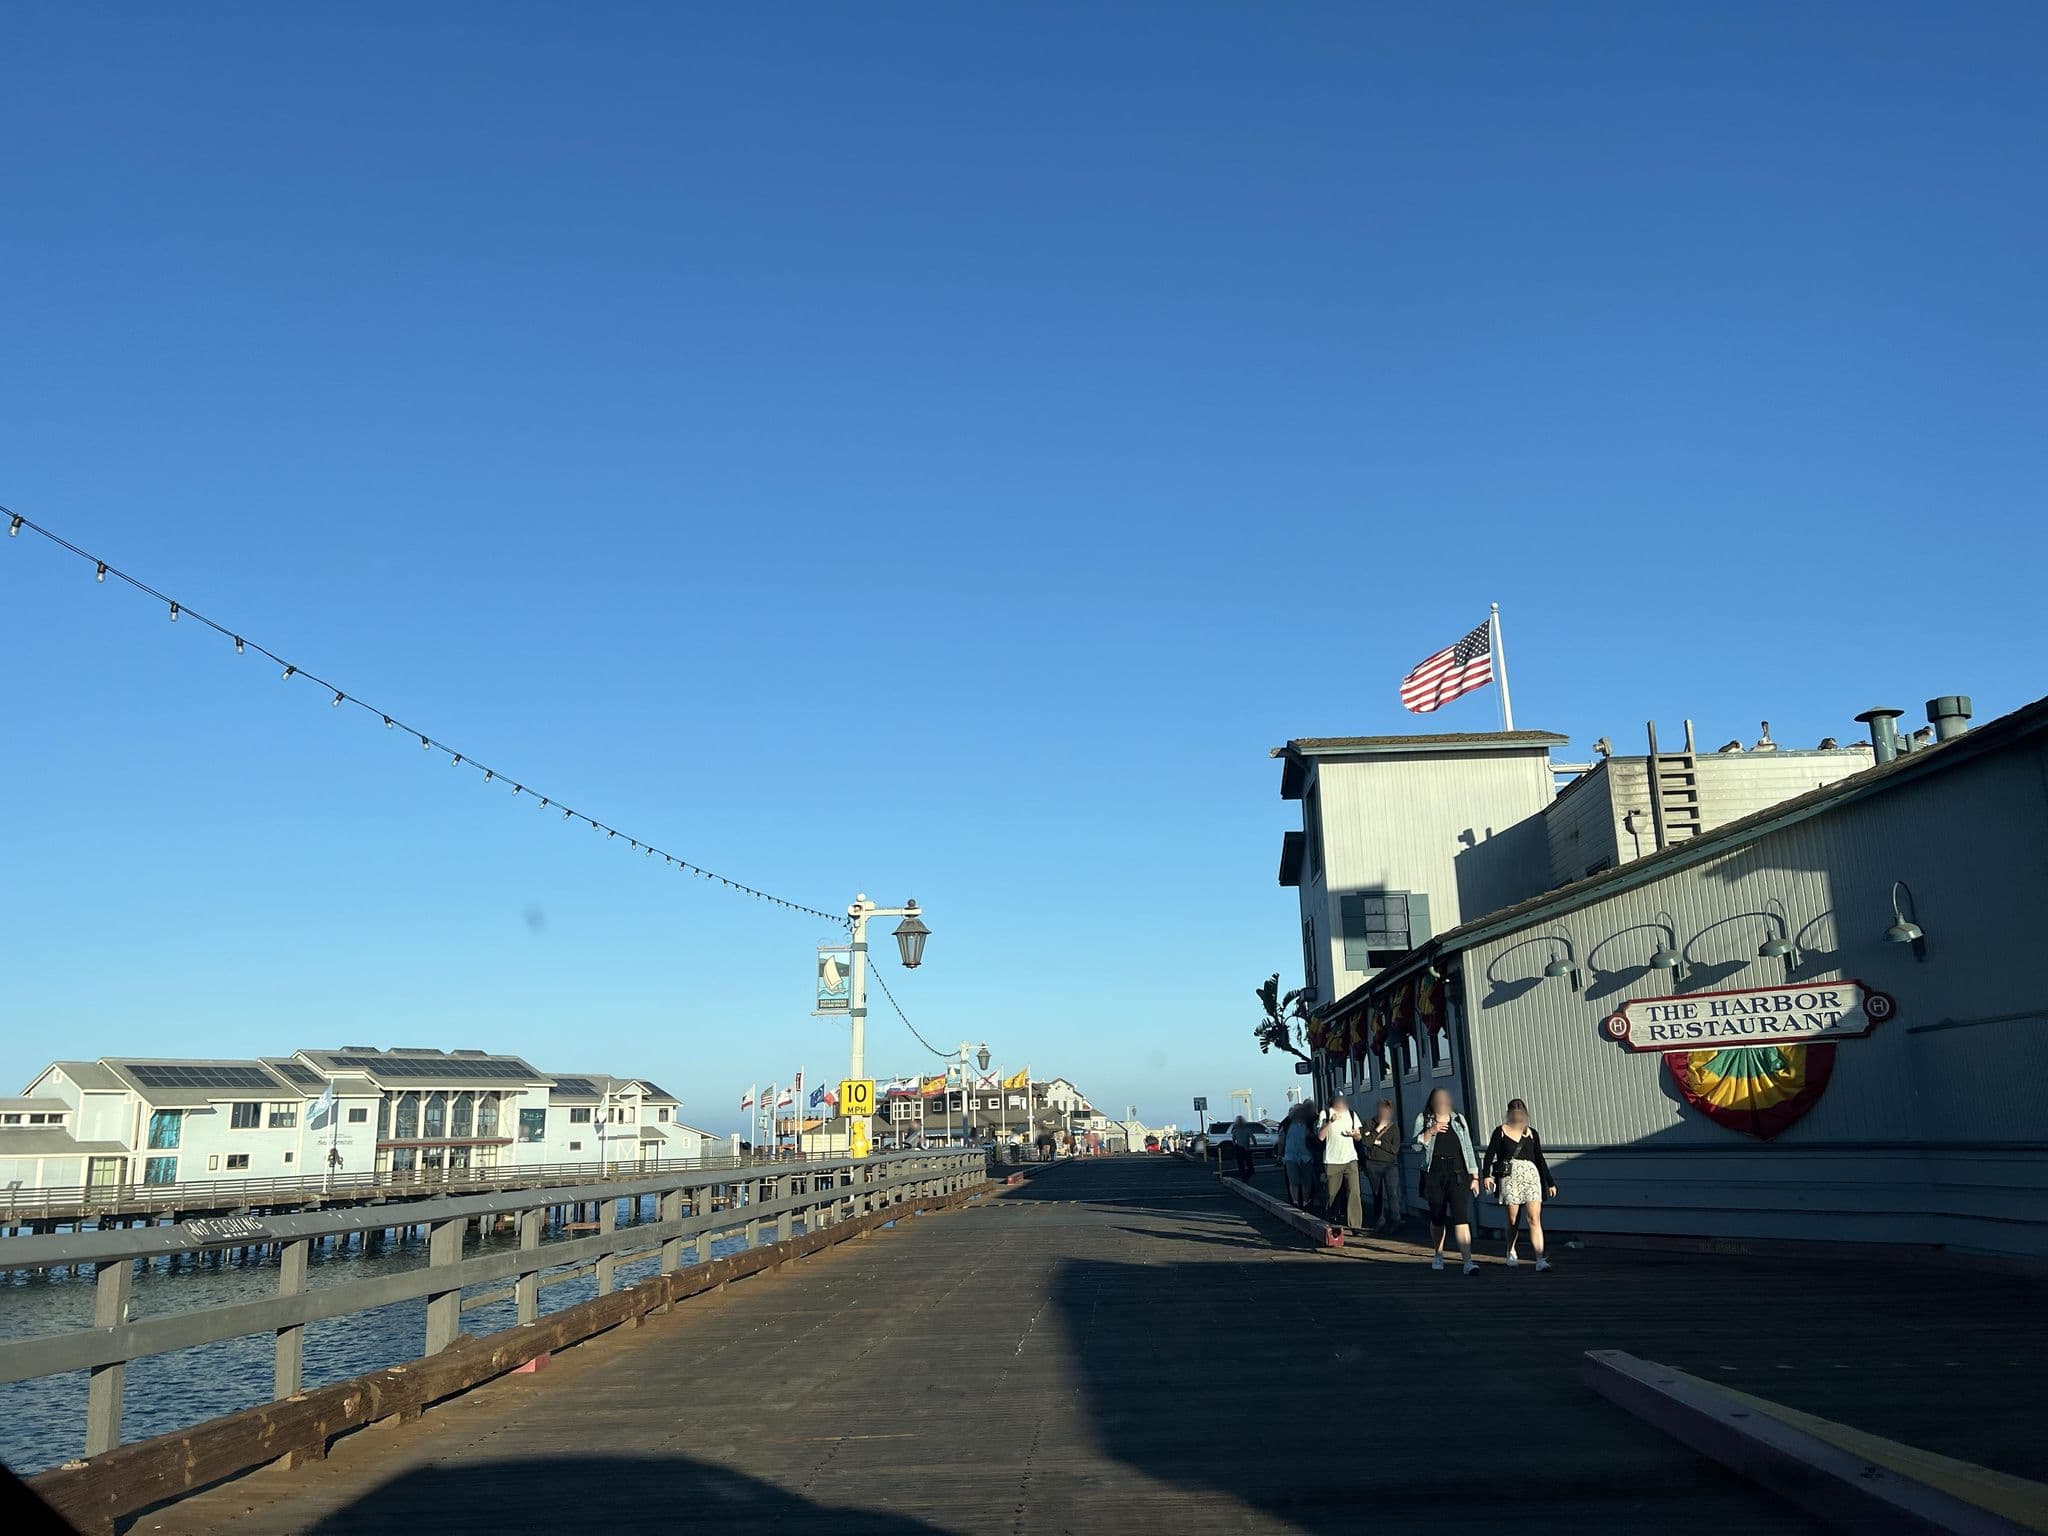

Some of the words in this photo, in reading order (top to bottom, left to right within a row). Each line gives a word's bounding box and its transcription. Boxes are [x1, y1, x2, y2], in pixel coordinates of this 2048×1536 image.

[1645, 1003, 1698, 1022] THE
[1710, 991, 1843, 1018] HARBOR
[1648, 1011, 1844, 1041] RESTAURANT
[847, 1083, 867, 1103] 10
[847, 1105, 867, 1114] MPH
[188, 1221, 209, 1236] NO
[209, 1216, 263, 1233] FISHING
